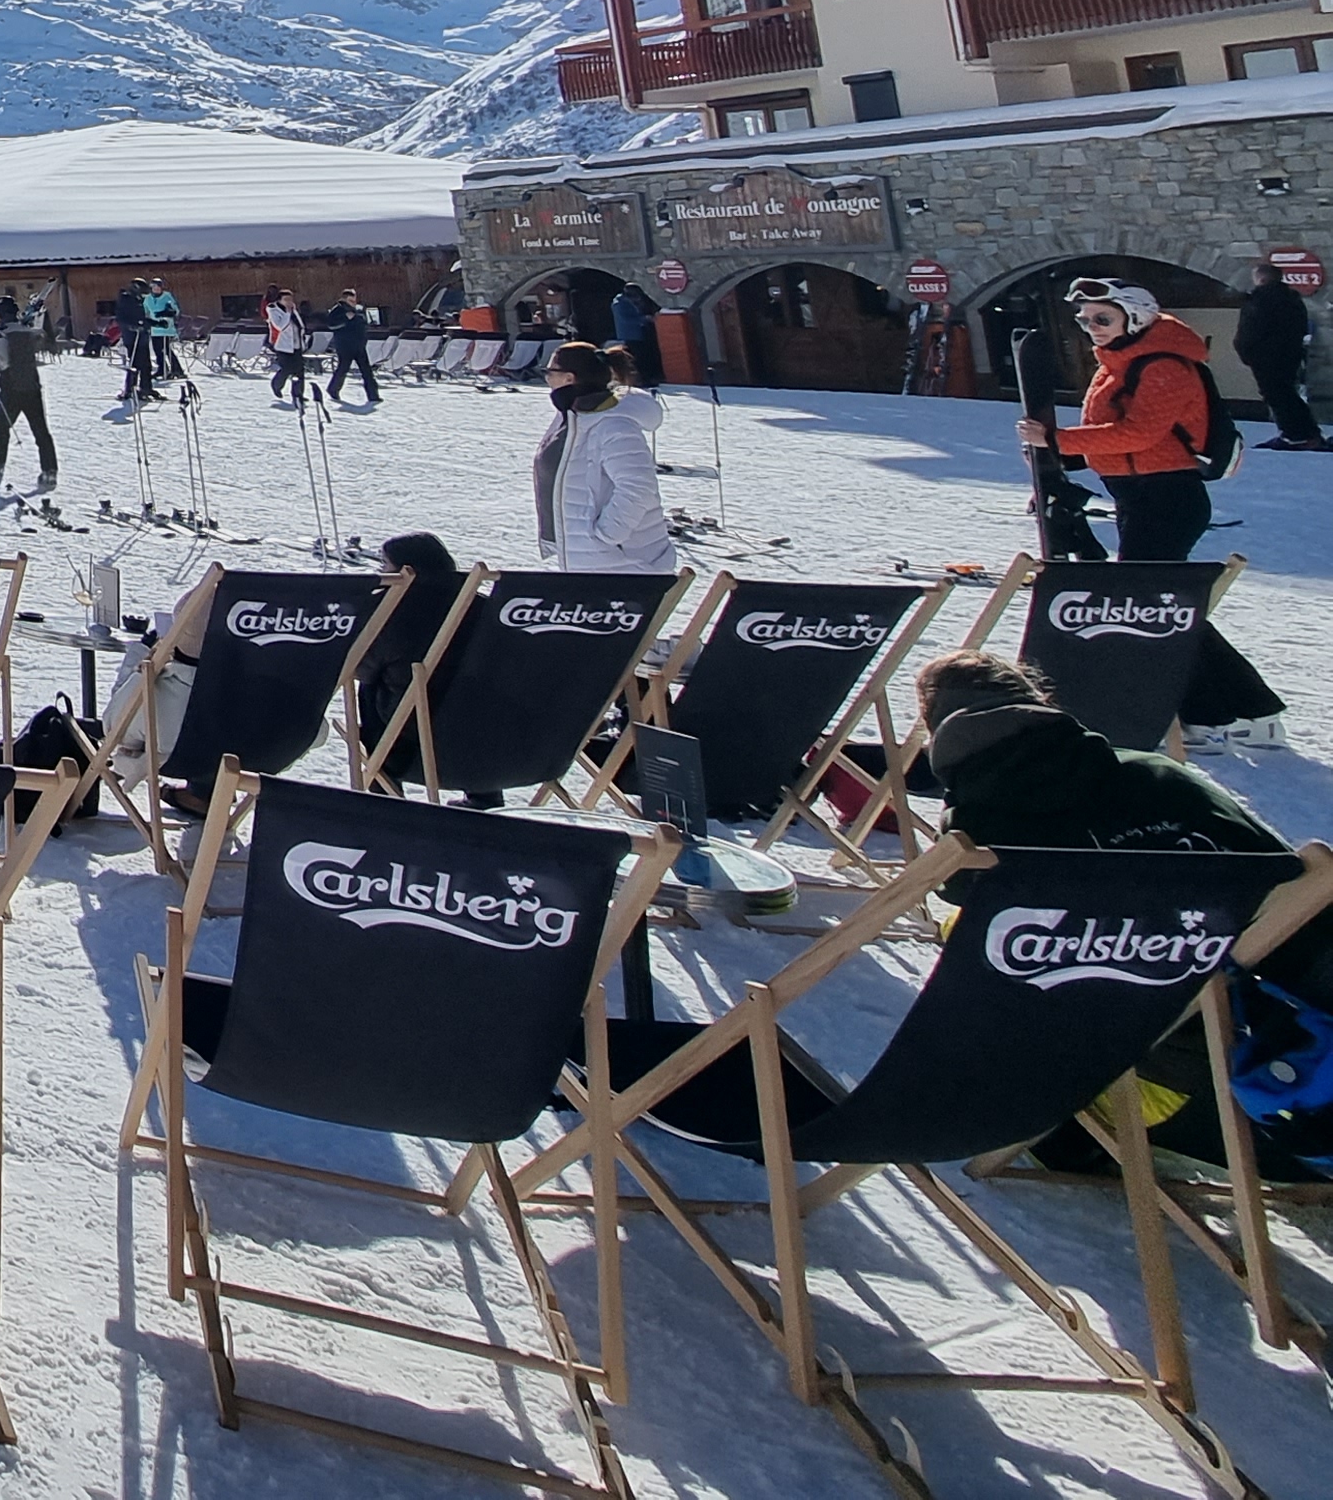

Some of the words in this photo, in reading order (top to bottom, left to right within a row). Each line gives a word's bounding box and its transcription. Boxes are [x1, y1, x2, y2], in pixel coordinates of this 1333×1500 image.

[514, 213, 531, 228] La
[675, 200, 760, 220] Restaurant
[765, 197, 785, 215] de
[729, 229, 747, 241] Bar
[761, 227, 789, 240] Take
[792, 226, 822, 240] Away
[909, 283, 940, 293] CLASSE
[941, 283, 947, 293] 3
[1281, 273, 1309, 285] ASSE
[1311, 273, 1321, 285] 2
[227, 601, 356, 646] Carlsberg
[499, 597, 643, 634] Carlsberg
[737, 612, 889, 651] Carlsberg
[1049, 591, 1196, 639] Carlsberg
[284, 841, 580, 950] Carlsberg
[986, 907, 1233, 990] Carlsberg
